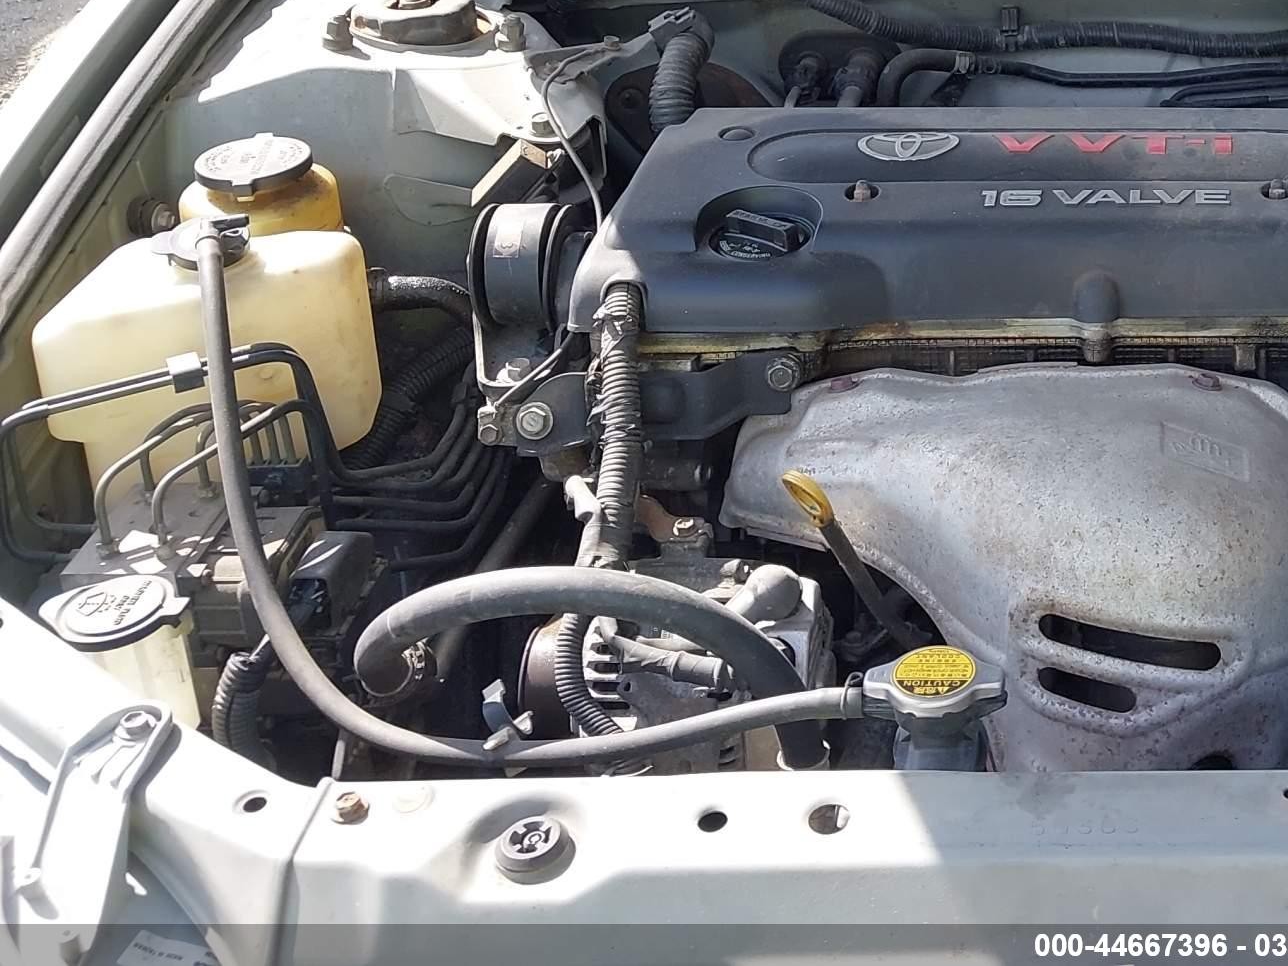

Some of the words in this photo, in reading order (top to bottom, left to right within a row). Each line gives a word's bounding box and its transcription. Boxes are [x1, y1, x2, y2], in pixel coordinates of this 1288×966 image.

[981, 189, 1042, 206] 16
[1052, 189, 1231, 205] VALVE
[903, 679, 961, 687] CAUTION
